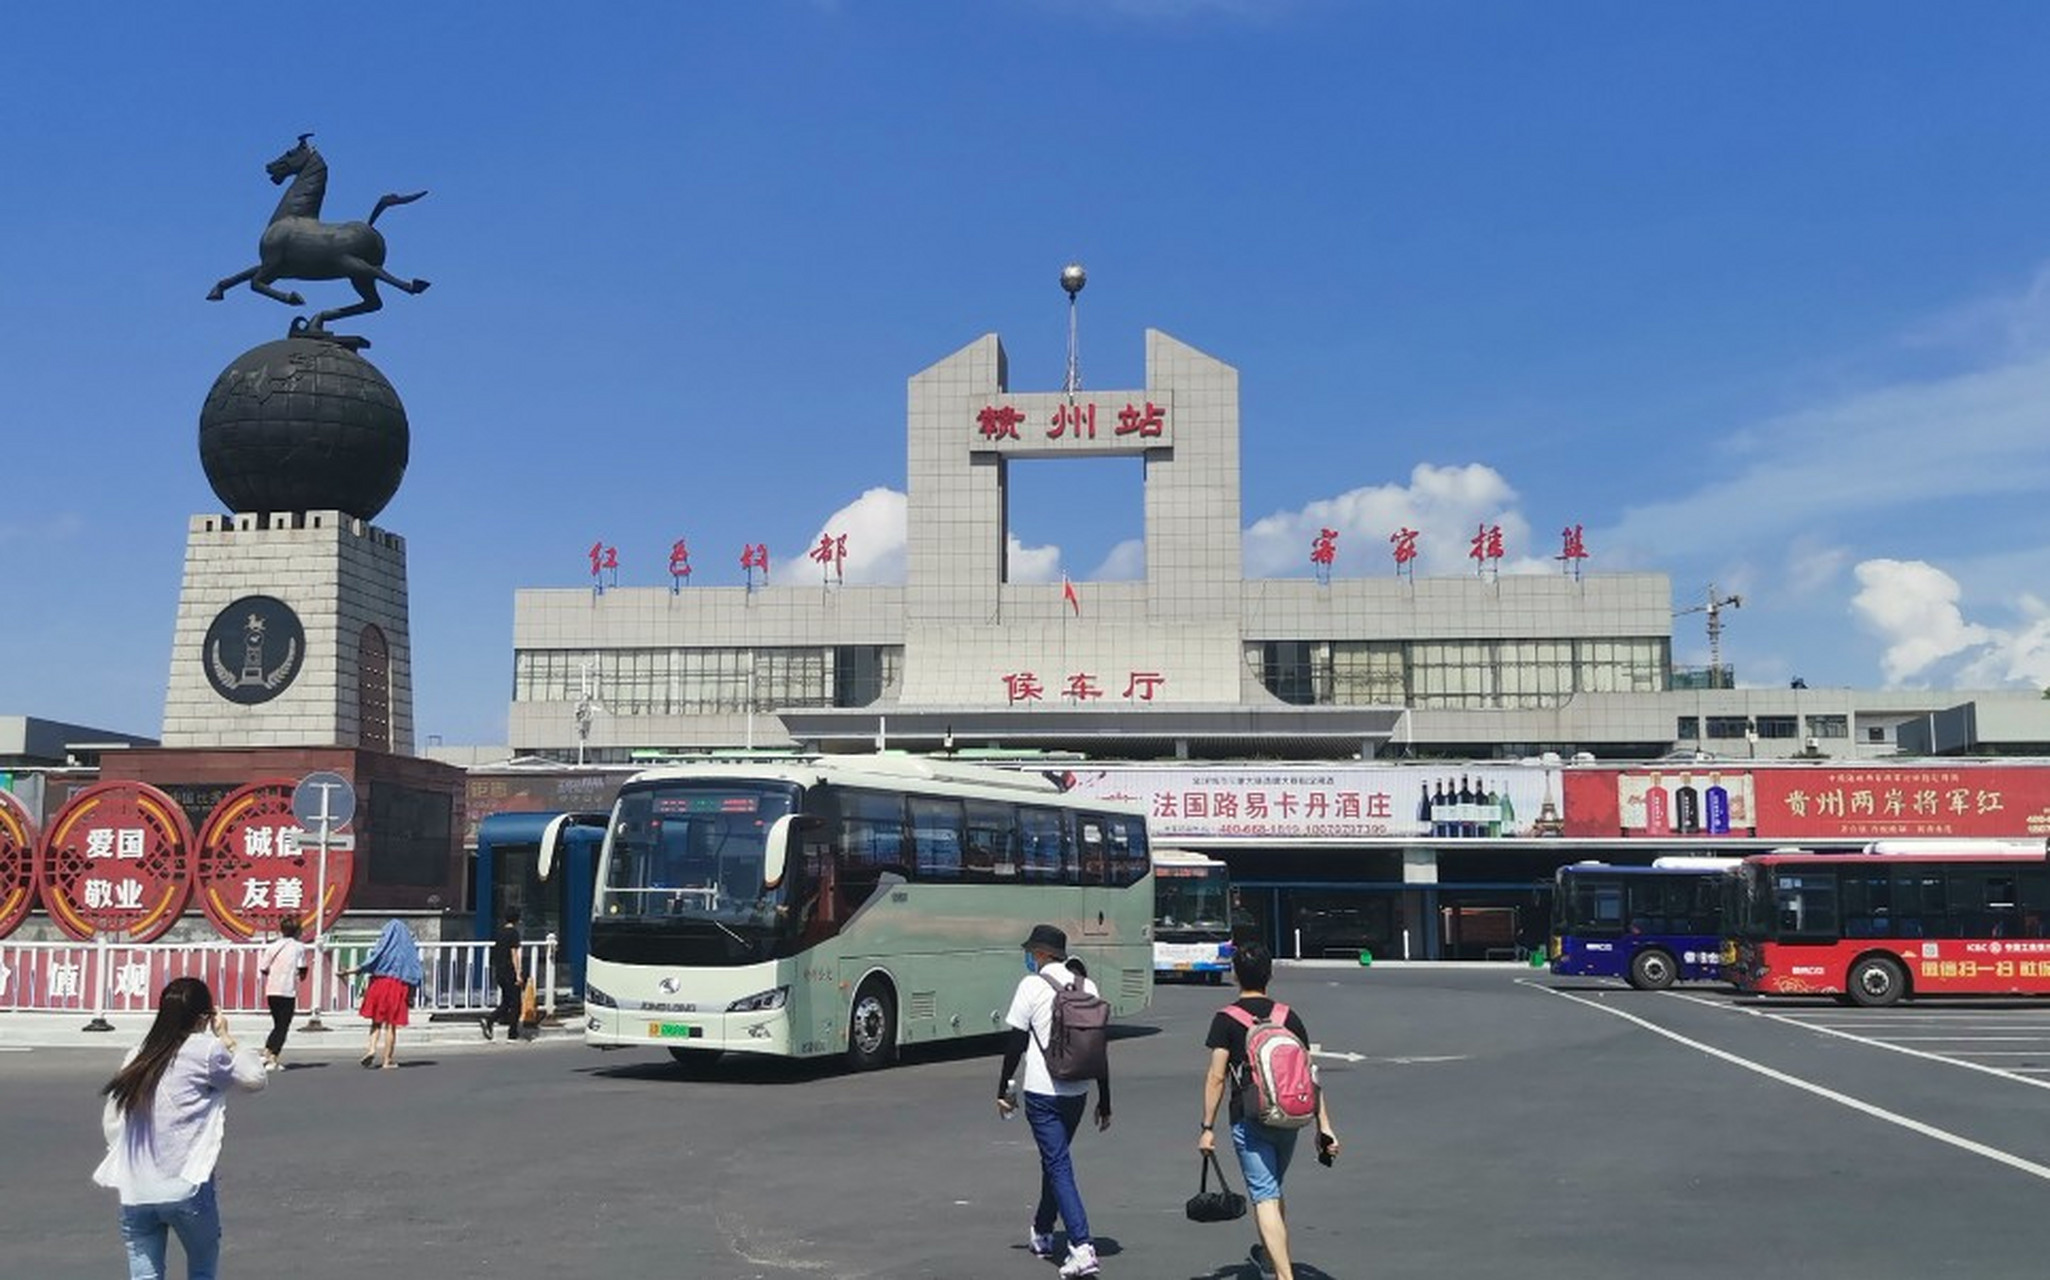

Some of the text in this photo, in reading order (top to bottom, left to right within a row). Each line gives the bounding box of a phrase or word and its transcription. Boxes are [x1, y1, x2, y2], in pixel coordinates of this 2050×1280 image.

[977, 402, 1166, 441] 赣州站
[589, 533, 848, 578] 红色故都
[1310, 523, 1589, 565] 客家摇篮
[1001, 672, 1166, 701] 候车厅
[1152, 791, 1394, 820] 法国路易卡丹酒庄
[1784, 788, 2005, 818] 贵州两岸将军红
[85, 828, 146, 860] 爱国
[243, 825, 306, 858] 诚信
[83, 878, 145, 910] 敬业
[241, 877, 304, 910] 友善
[1921, 960, 2015, 978] 微信扫一扫
